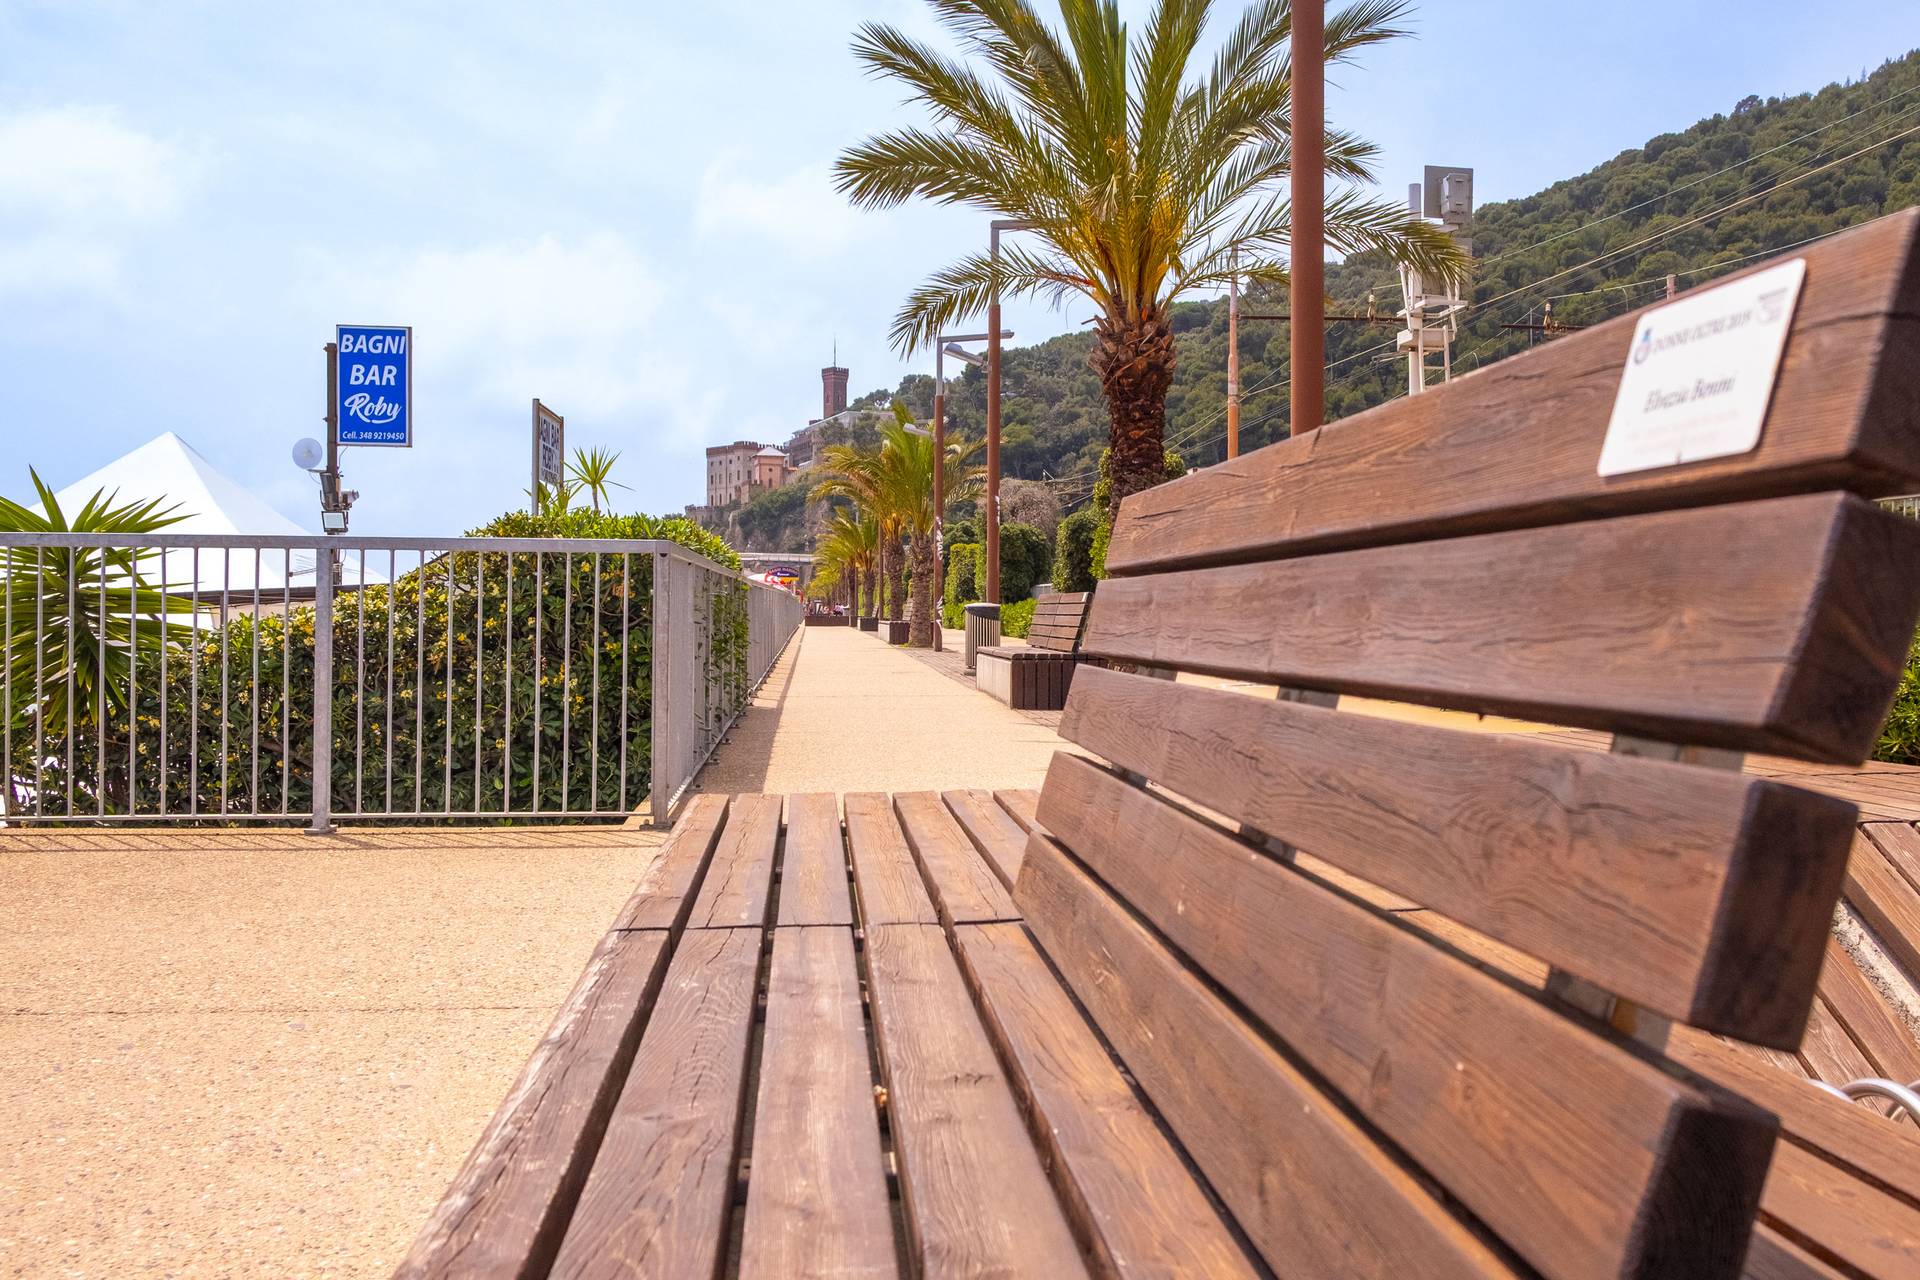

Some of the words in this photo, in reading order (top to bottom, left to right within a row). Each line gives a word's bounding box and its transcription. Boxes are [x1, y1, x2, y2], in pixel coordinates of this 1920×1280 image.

[340, 334, 405, 354] BAGNI
[349, 364, 397, 386] BAR
[344, 392, 402, 424] Roby
[342, 431, 358, 440] Cell.
[359, 431, 372, 440] 348
[374, 431, 405, 440] 9219450
